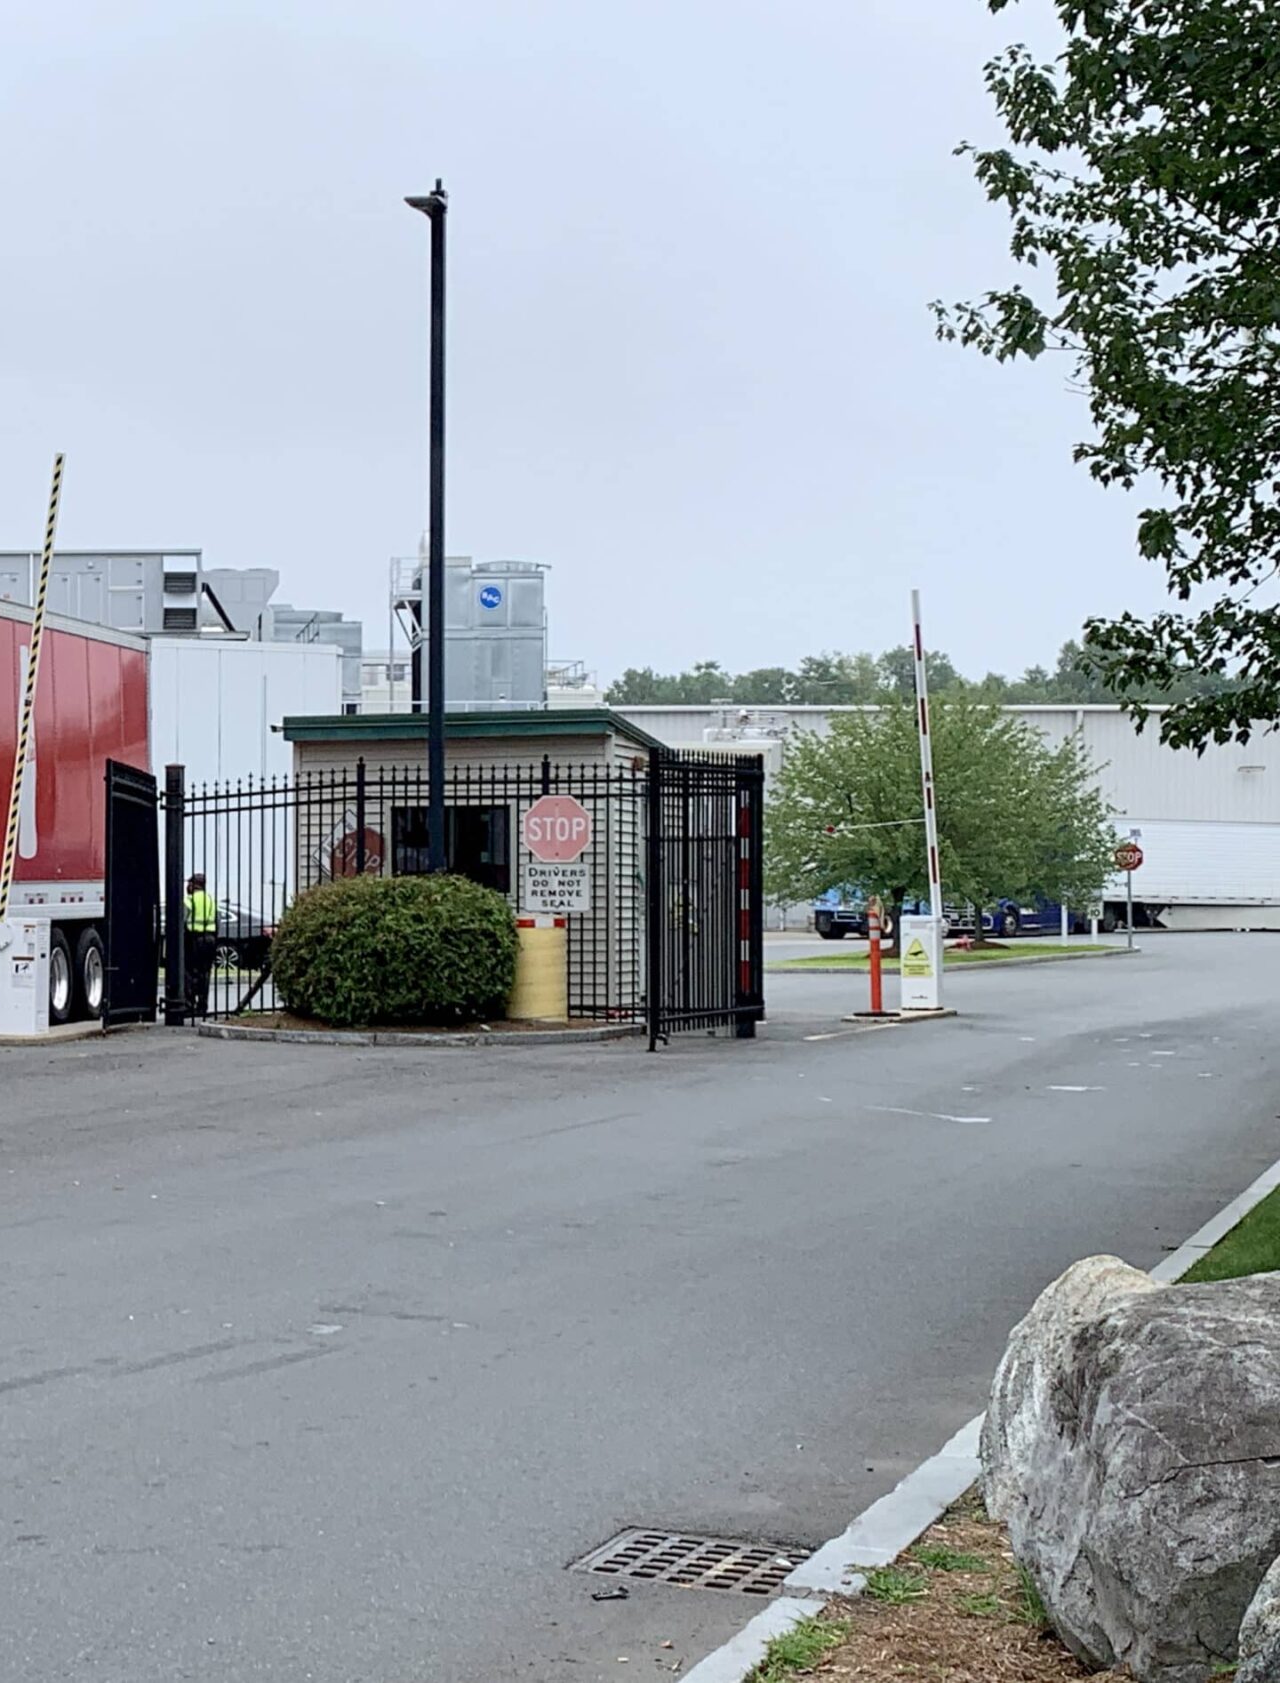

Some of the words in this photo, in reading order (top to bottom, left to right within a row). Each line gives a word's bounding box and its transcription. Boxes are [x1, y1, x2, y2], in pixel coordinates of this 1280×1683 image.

[528, 816, 587, 841] STOP
[528, 866, 587, 878] DRIVERS
[532, 879, 549, 888] DO
[557, 879, 582, 888] NOT
[530, 889, 583, 898] REMOVE
[541, 899, 575, 908] SEAL
